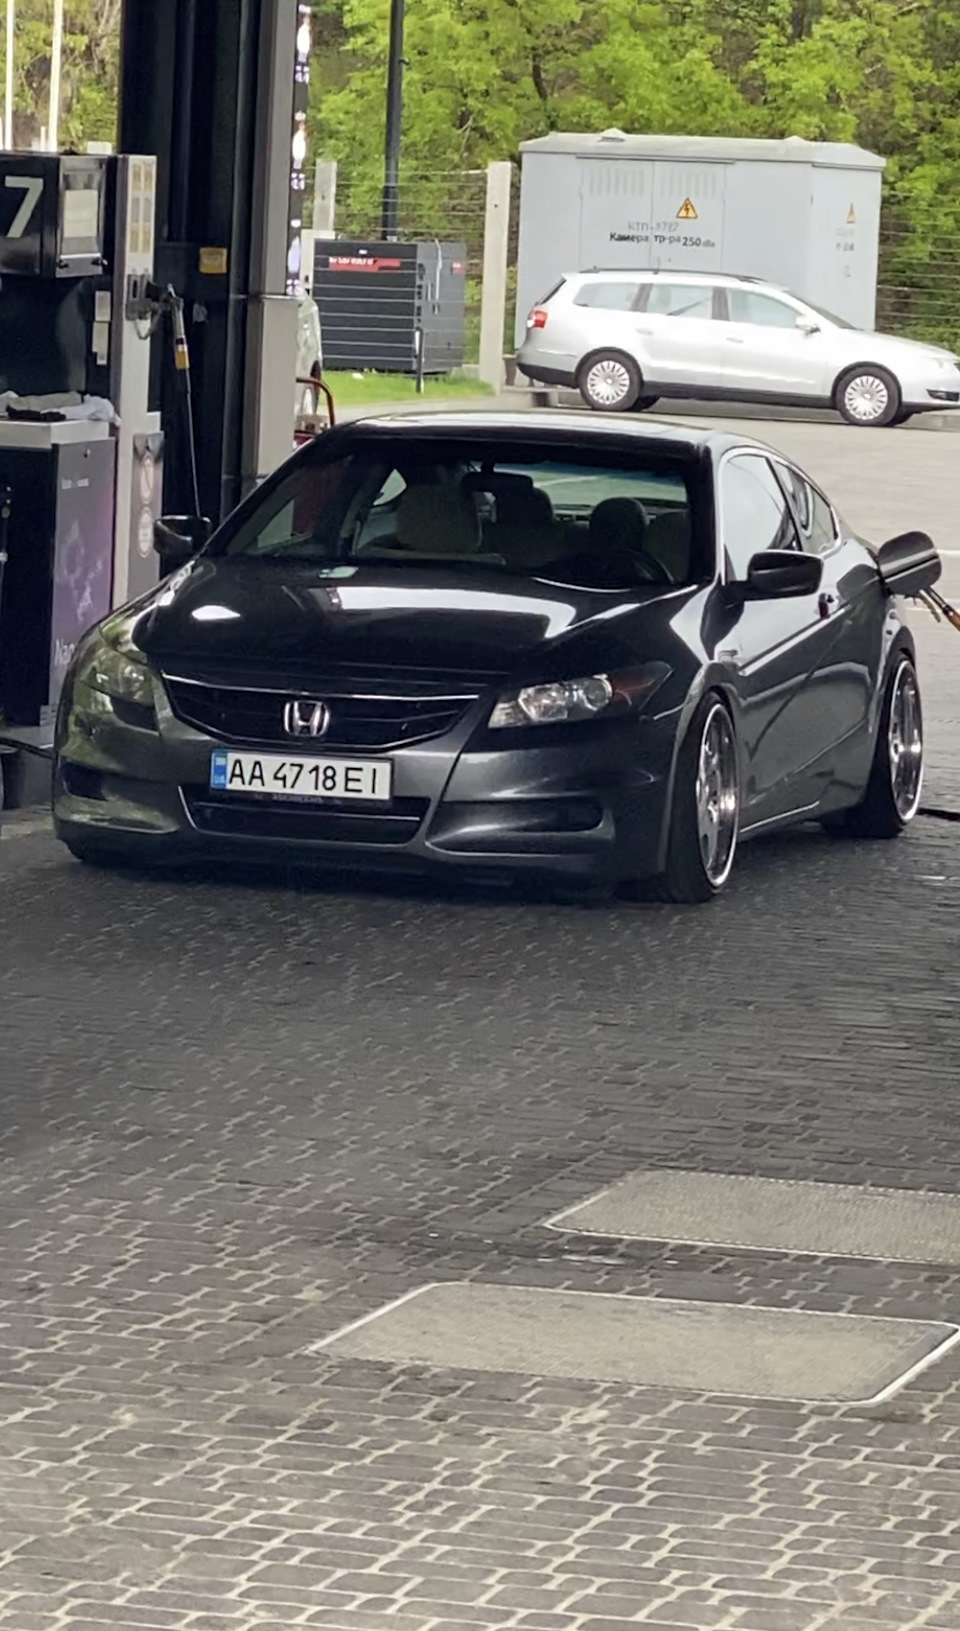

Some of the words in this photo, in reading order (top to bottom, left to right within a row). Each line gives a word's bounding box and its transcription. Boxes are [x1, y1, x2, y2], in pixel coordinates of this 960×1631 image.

[4, 176, 44, 238] 7
[610, 232, 649, 244] Камера
[682, 237, 702, 247] 250
[229, 759, 265, 787] AA
[273, 763, 337, 791] 4718
[344, 767, 377, 794] EI
